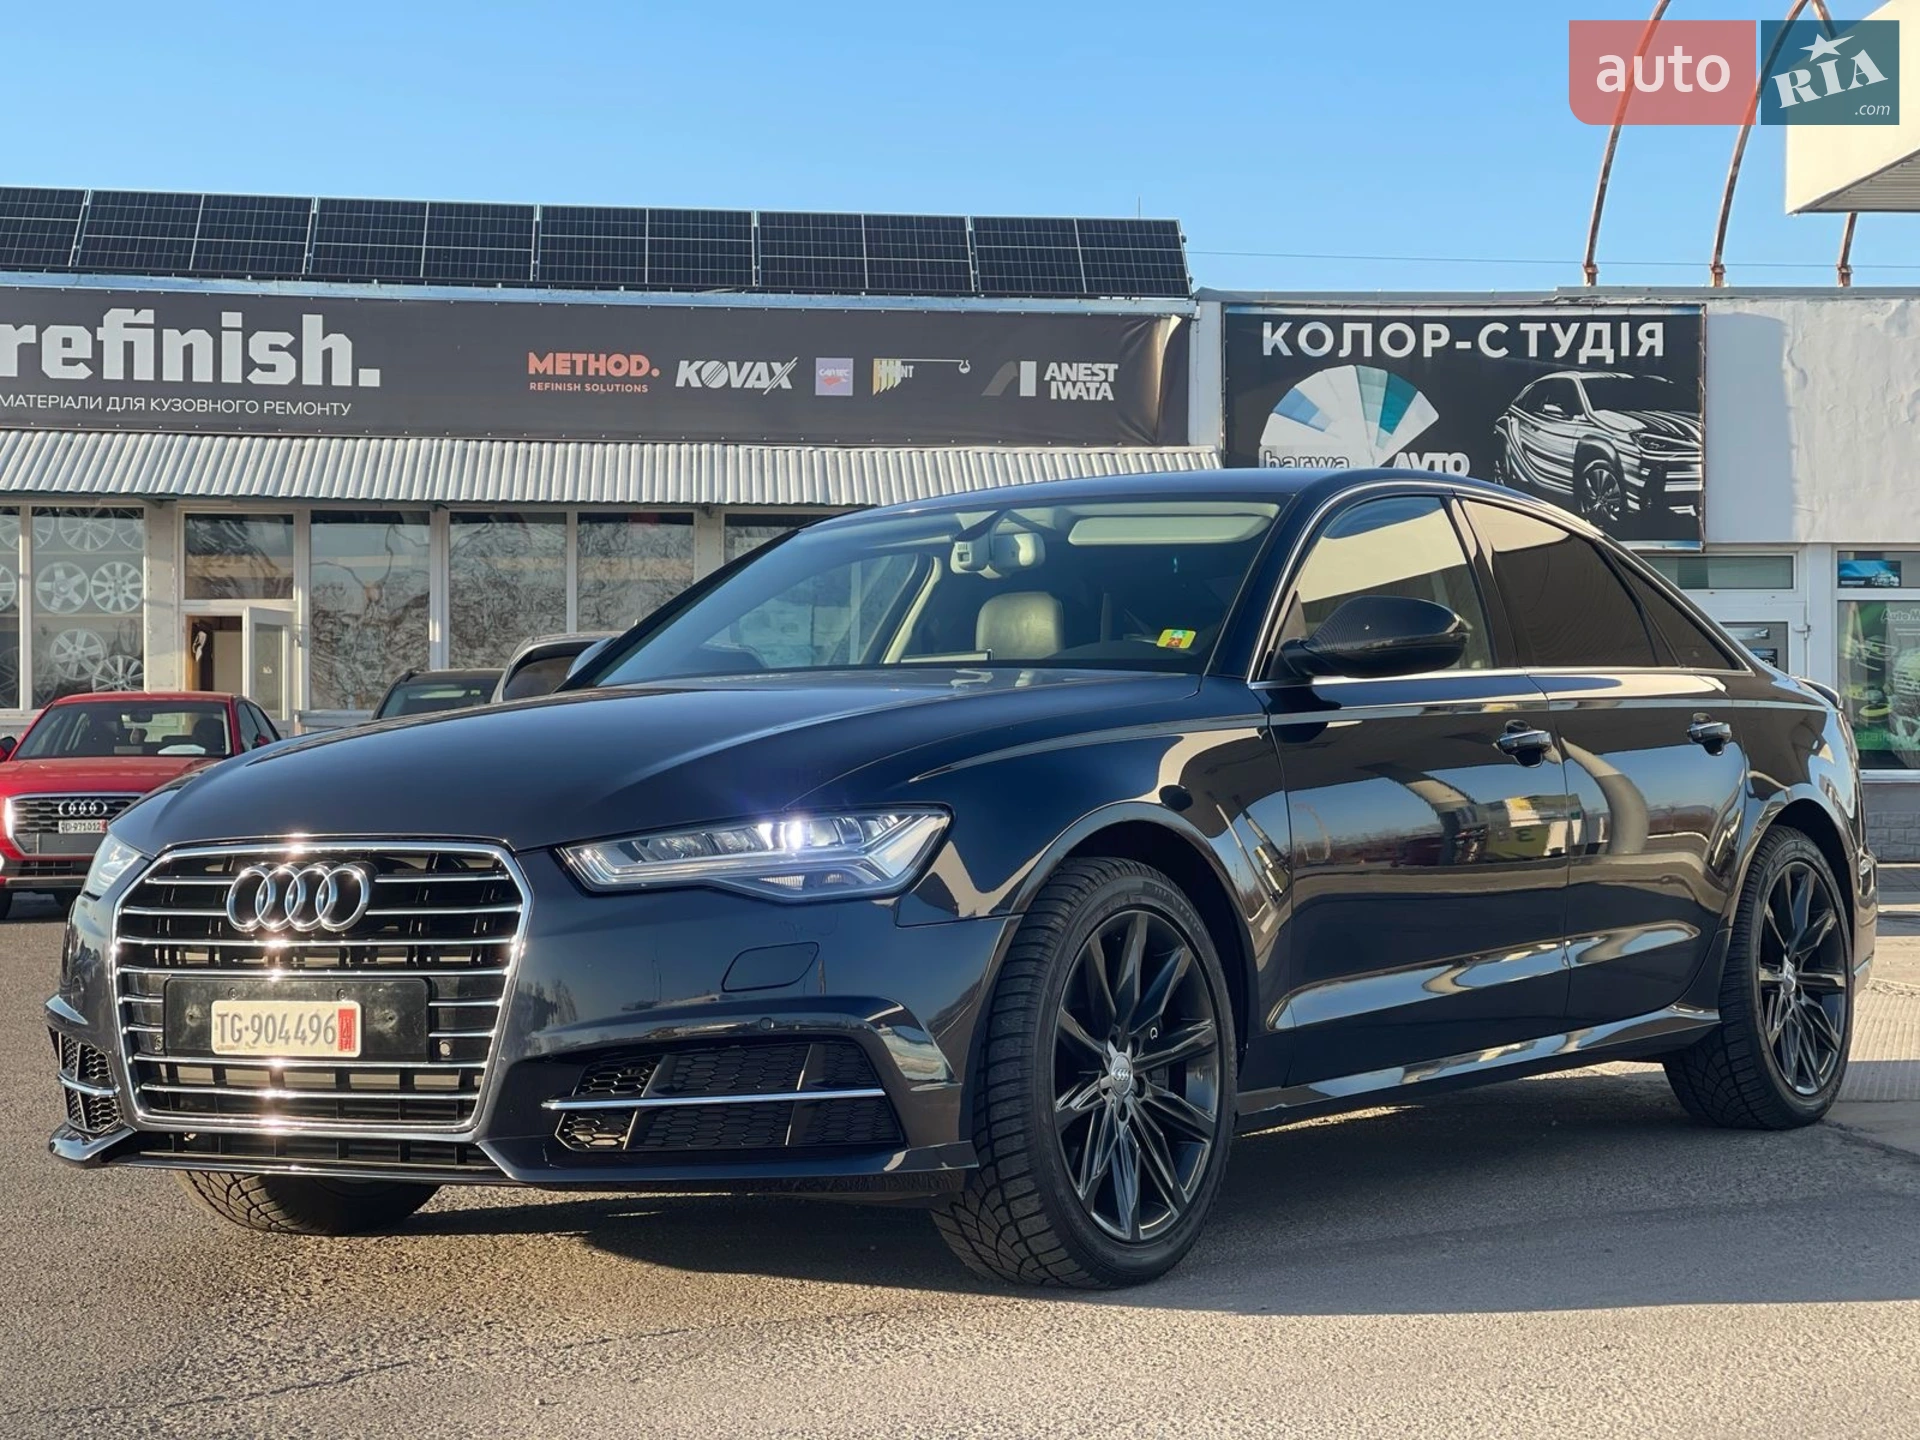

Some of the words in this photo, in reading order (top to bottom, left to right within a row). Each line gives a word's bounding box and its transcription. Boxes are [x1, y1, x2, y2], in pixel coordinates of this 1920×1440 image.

[0, 308, 381, 388] refinish.
[528, 352, 660, 378] METHOD.
[675, 356, 798, 396] KOVAX
[1044, 362, 1119, 382] ANEST
[529, 382, 581, 392] REFINISH
[584, 383, 649, 393] SOLUTIONS
[1050, 381, 1115, 401] IWATA
[0, 394, 102, 410] МАТЕРІАЛИ
[106, 396, 145, 413] ДЛЯ
[150, 397, 259, 414] КУЗОВНОГО
[263, 400, 352, 416] РЕМОНТУ
